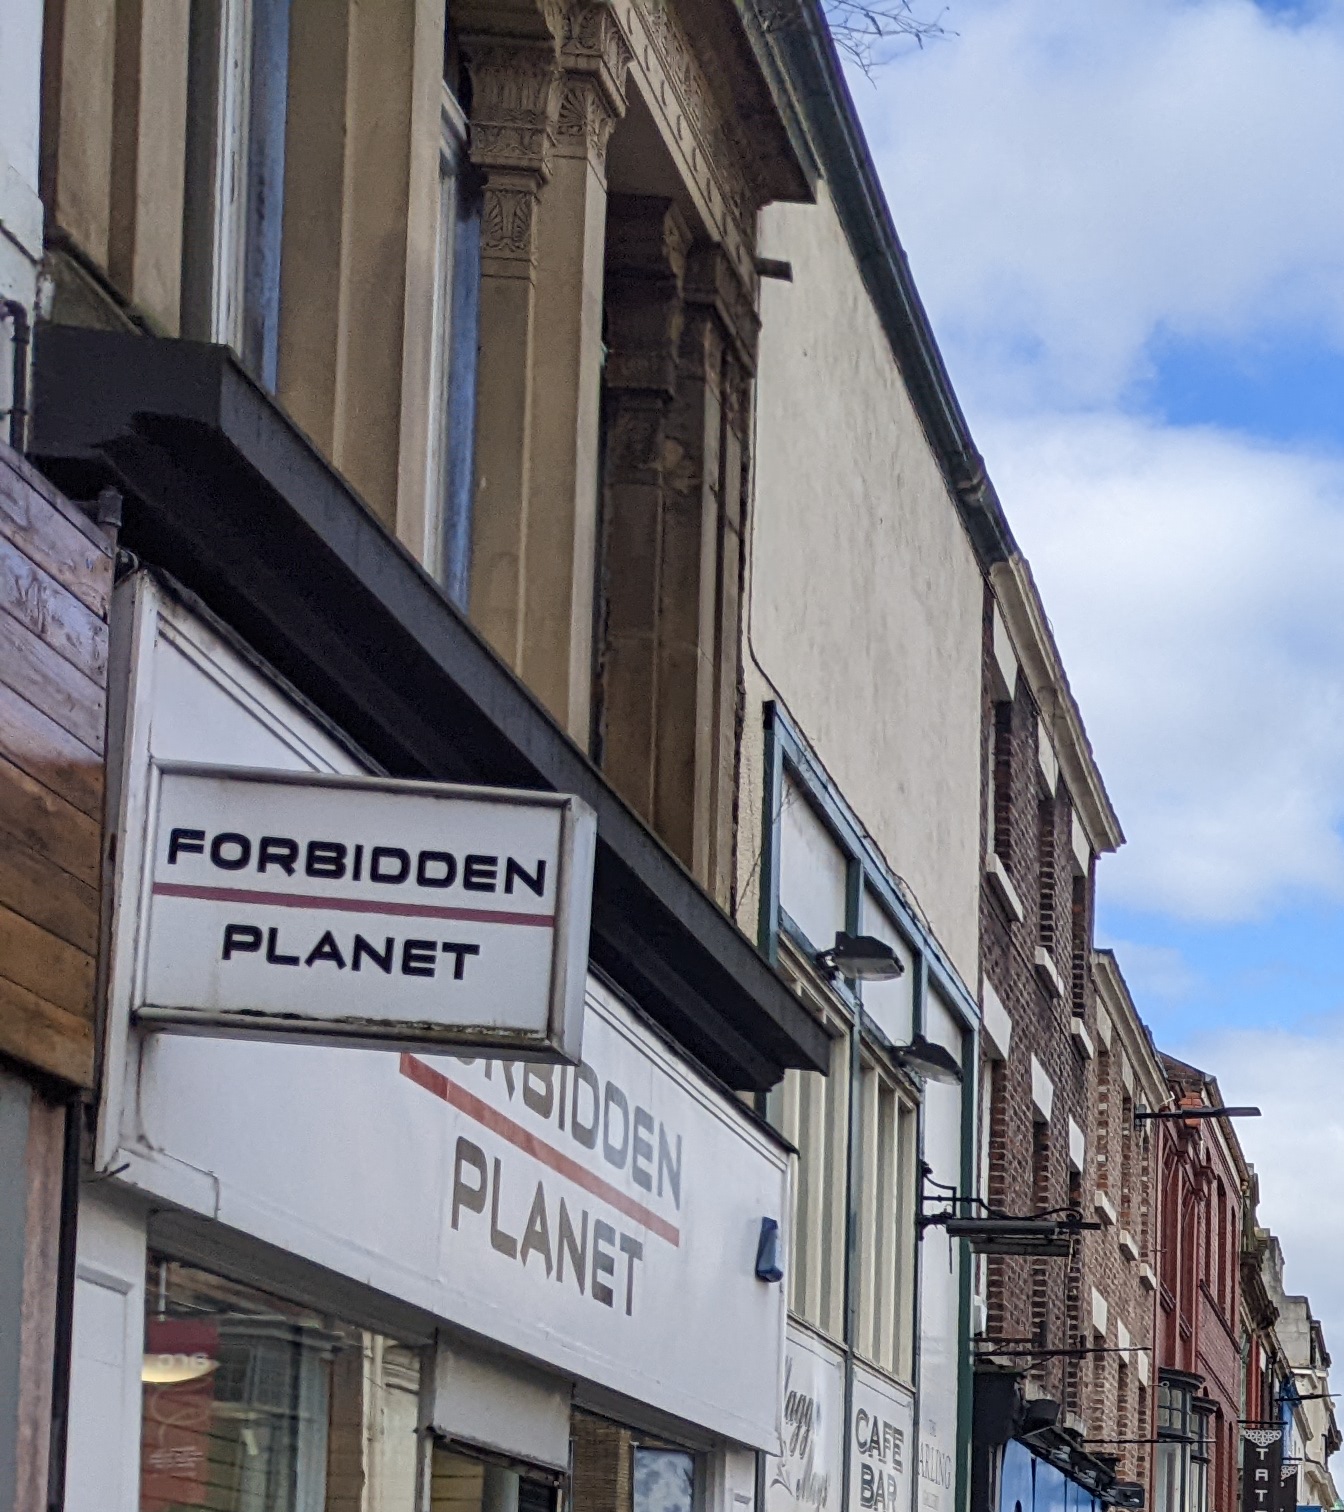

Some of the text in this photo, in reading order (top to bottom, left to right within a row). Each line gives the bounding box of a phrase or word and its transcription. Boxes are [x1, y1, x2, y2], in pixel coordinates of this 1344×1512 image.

[166, 827, 548, 898] FORBIDDEN
[221, 922, 482, 983] PLANET
[453, 1050, 684, 1212] RBIDDEN
[449, 1134, 645, 1318] PLANET
[855, 1407, 905, 1474] CAFE
